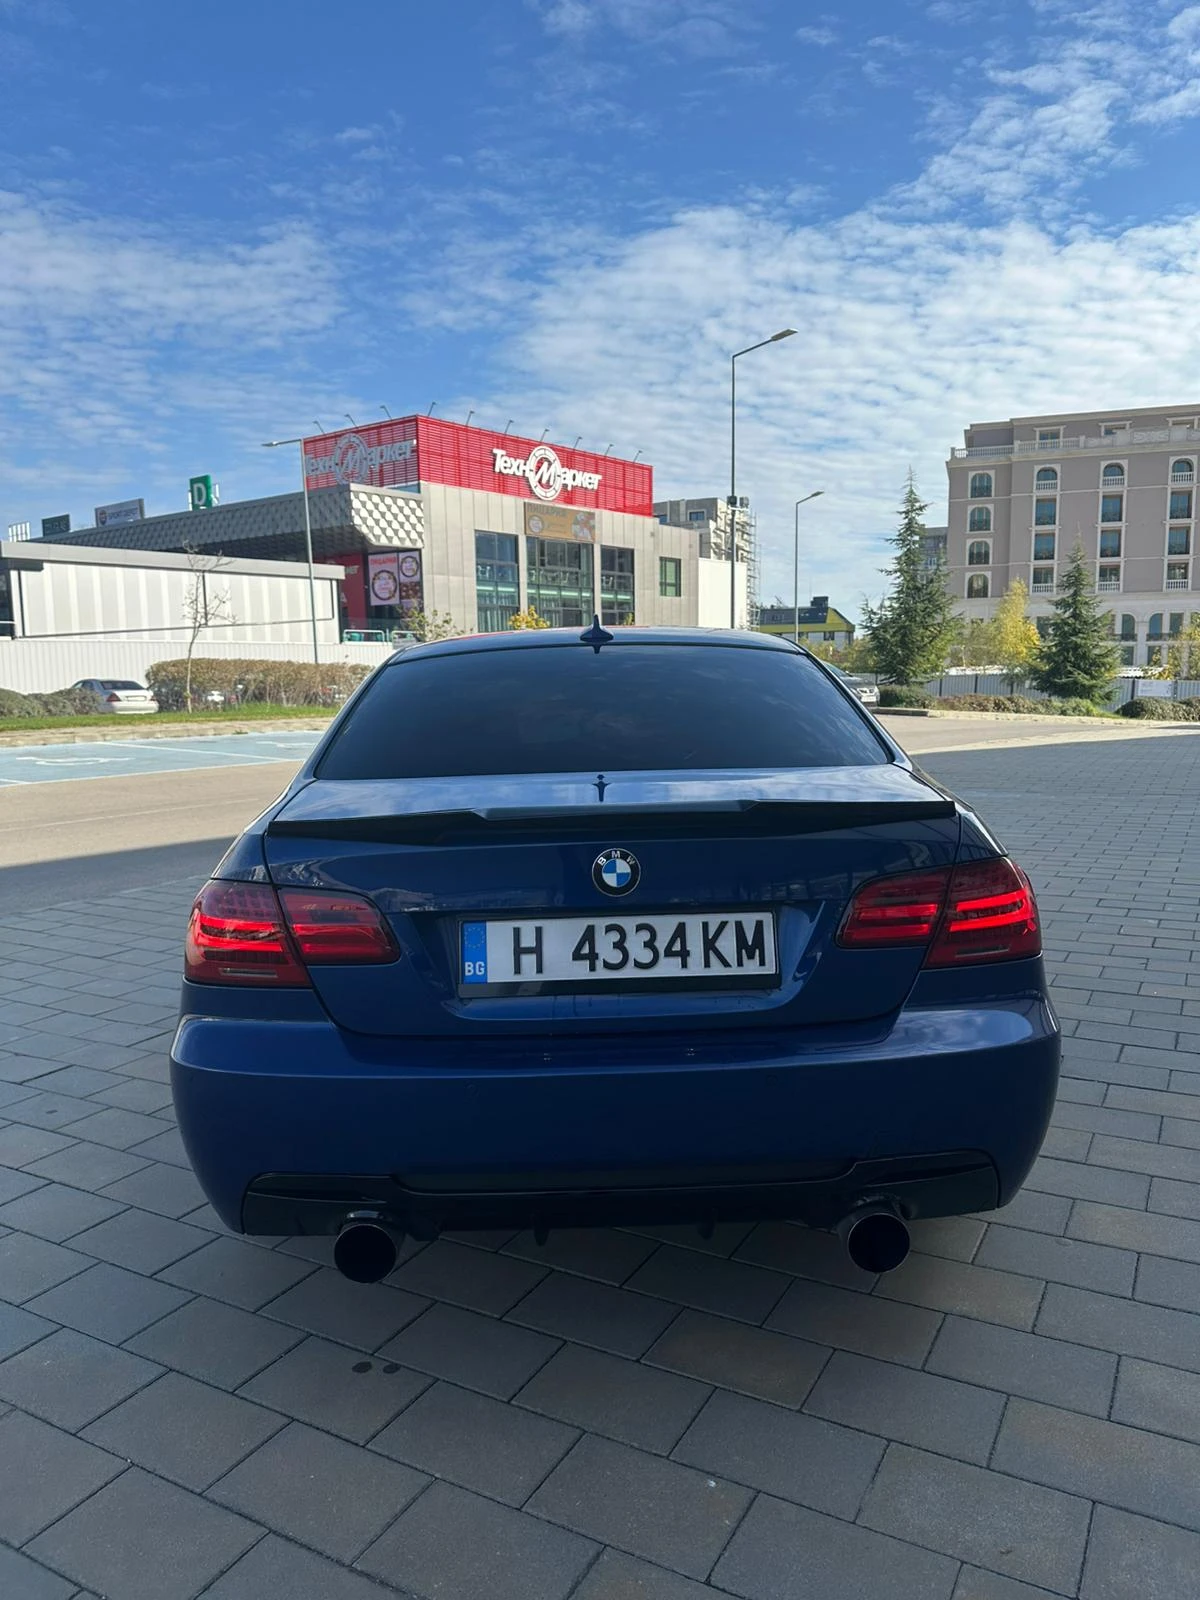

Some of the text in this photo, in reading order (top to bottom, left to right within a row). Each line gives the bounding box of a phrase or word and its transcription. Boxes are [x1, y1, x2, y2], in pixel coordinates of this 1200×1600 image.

[597, 850, 636, 866] BMW
[512, 919, 767, 976] H 4334 KM
[464, 961, 486, 977] BG
